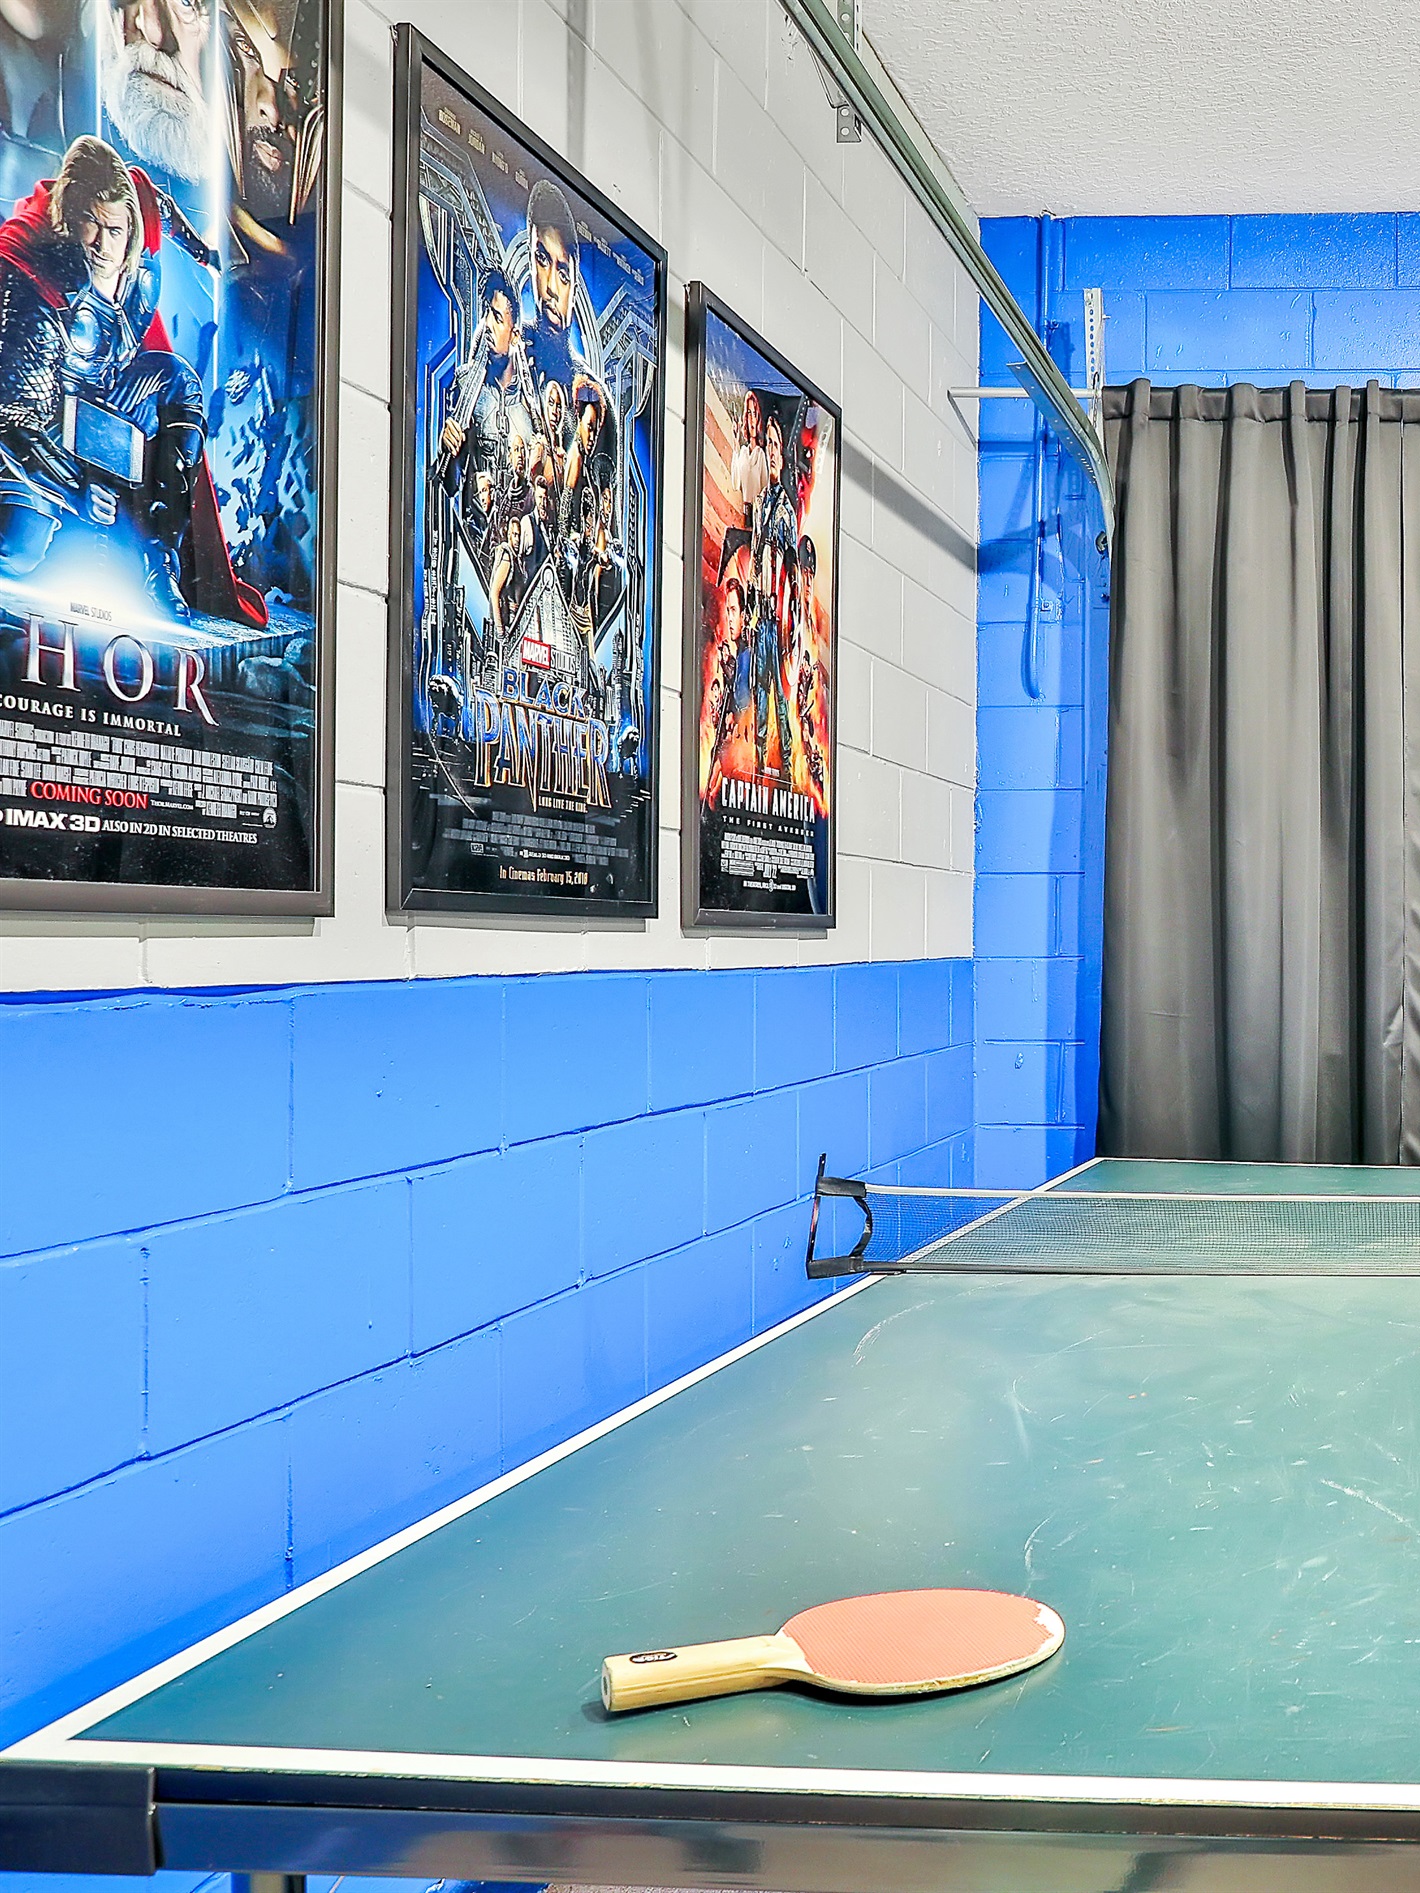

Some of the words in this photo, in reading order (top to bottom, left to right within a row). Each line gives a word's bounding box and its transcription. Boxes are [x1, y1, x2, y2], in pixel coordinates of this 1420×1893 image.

[20, 611, 220, 727] HOR
[0, 693, 74, 719] OURAGE
[80, 708, 97, 723] IS
[102, 712, 182, 737] IMMORTAL
[501, 665, 588, 721] BLACK
[474, 687, 612, 812] PANTHER
[30, 781, 102, 805] COMING
[104, 789, 148, 810] SOON
[722, 776, 769, 815] CAPTAIN
[772, 788, 815, 824] AMERICA
[5, 808, 69, 830] IMAX
[69, 814, 101, 833] 3D
[101, 820, 129, 833] ALSO
[129, 821, 143, 834] IN
[143, 823, 158, 835] 2D
[158, 825, 172, 836] IN
[172, 826, 216, 840] SELECTED
[215, 829, 258, 844] THEATRES
[499, 865, 507, 879] In
[508, 866, 536, 882] Cinemas
[536, 868, 565, 885] February
